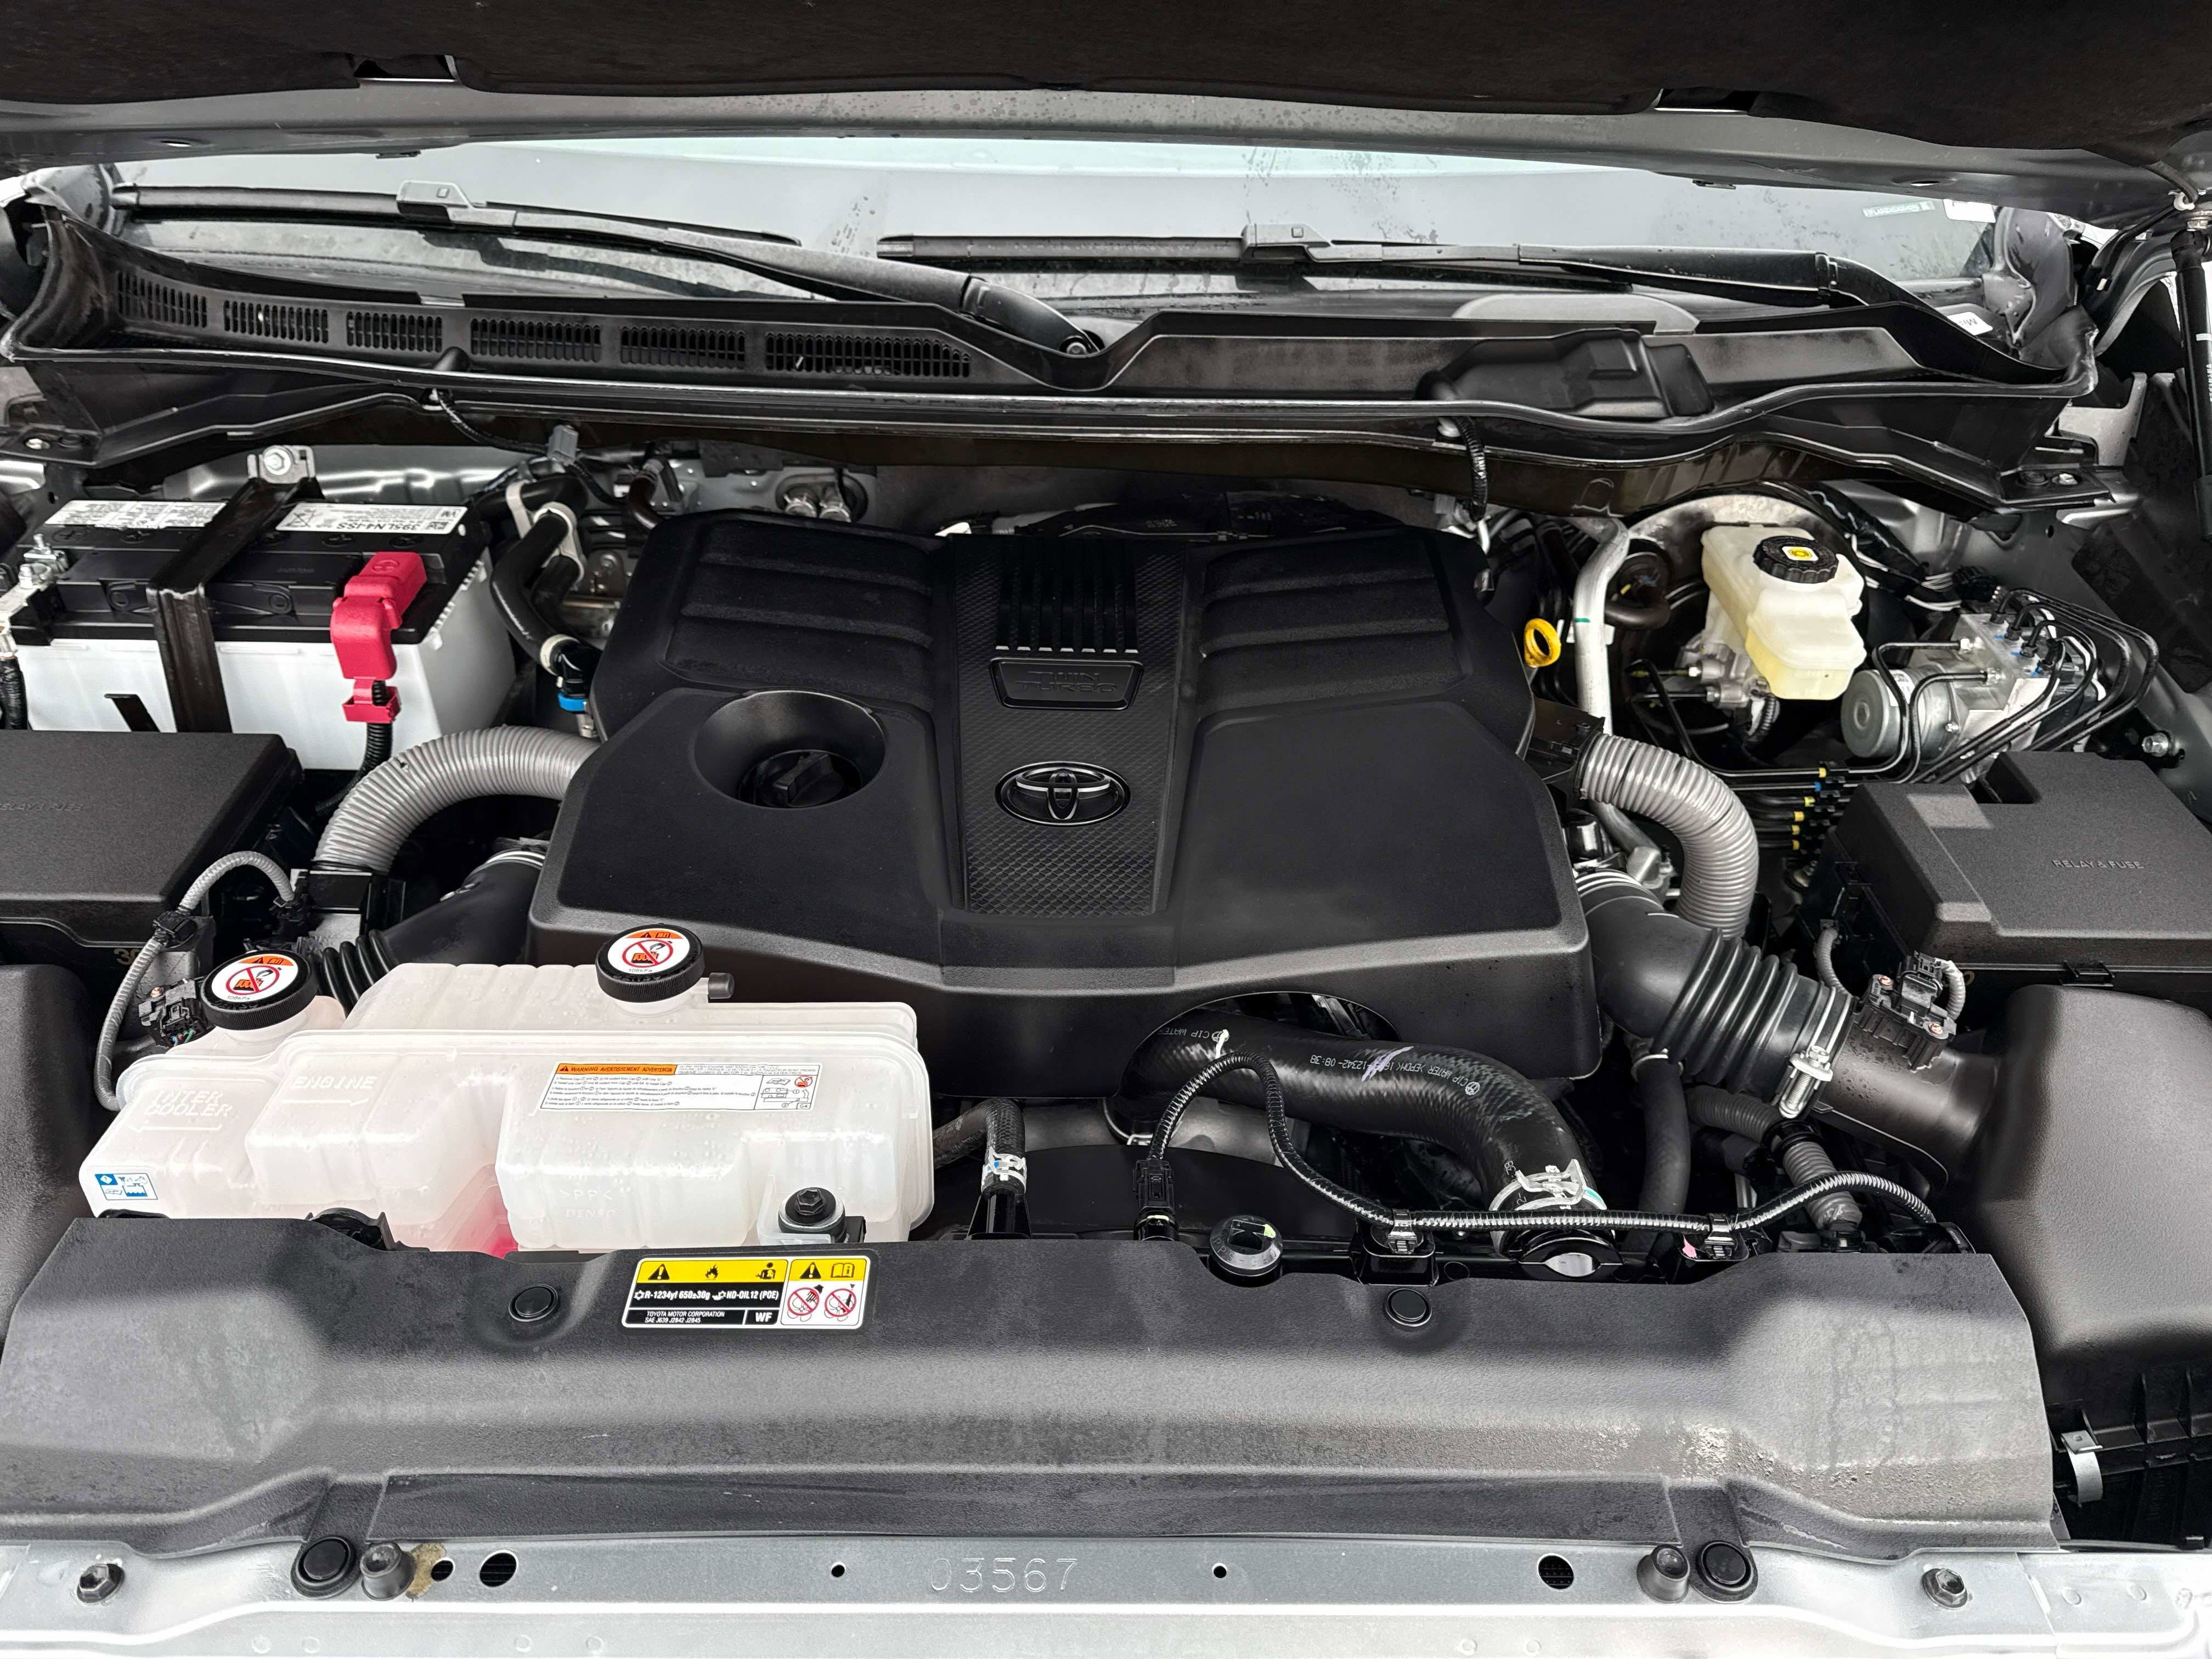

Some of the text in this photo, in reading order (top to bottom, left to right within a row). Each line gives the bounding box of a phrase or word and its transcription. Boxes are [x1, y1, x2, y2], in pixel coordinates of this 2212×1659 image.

[1028, 671, 1100, 681] TWIN
[1015, 680, 1118, 693] TURBO
[2052, 860, 2145, 870] RELAY & FUSE
[1190, 1030, 1210, 1039] CIP
[1338, 1059, 1395, 1071] 16-12342-
[1429, 1065, 1453, 1079] WATER
[292, 1075, 379, 1090] ENGINE
[1452, 1075, 1469, 1087] CIP
[155, 1090, 224, 1104] INTER
[145, 1103, 233, 1117] COOLER
[644, 1290, 779, 1300] R-1234yf 650±30g ND-OIL12 (POE)
[755, 1312, 772, 1322] WF
[929, 1557, 1078, 1593] 03567
